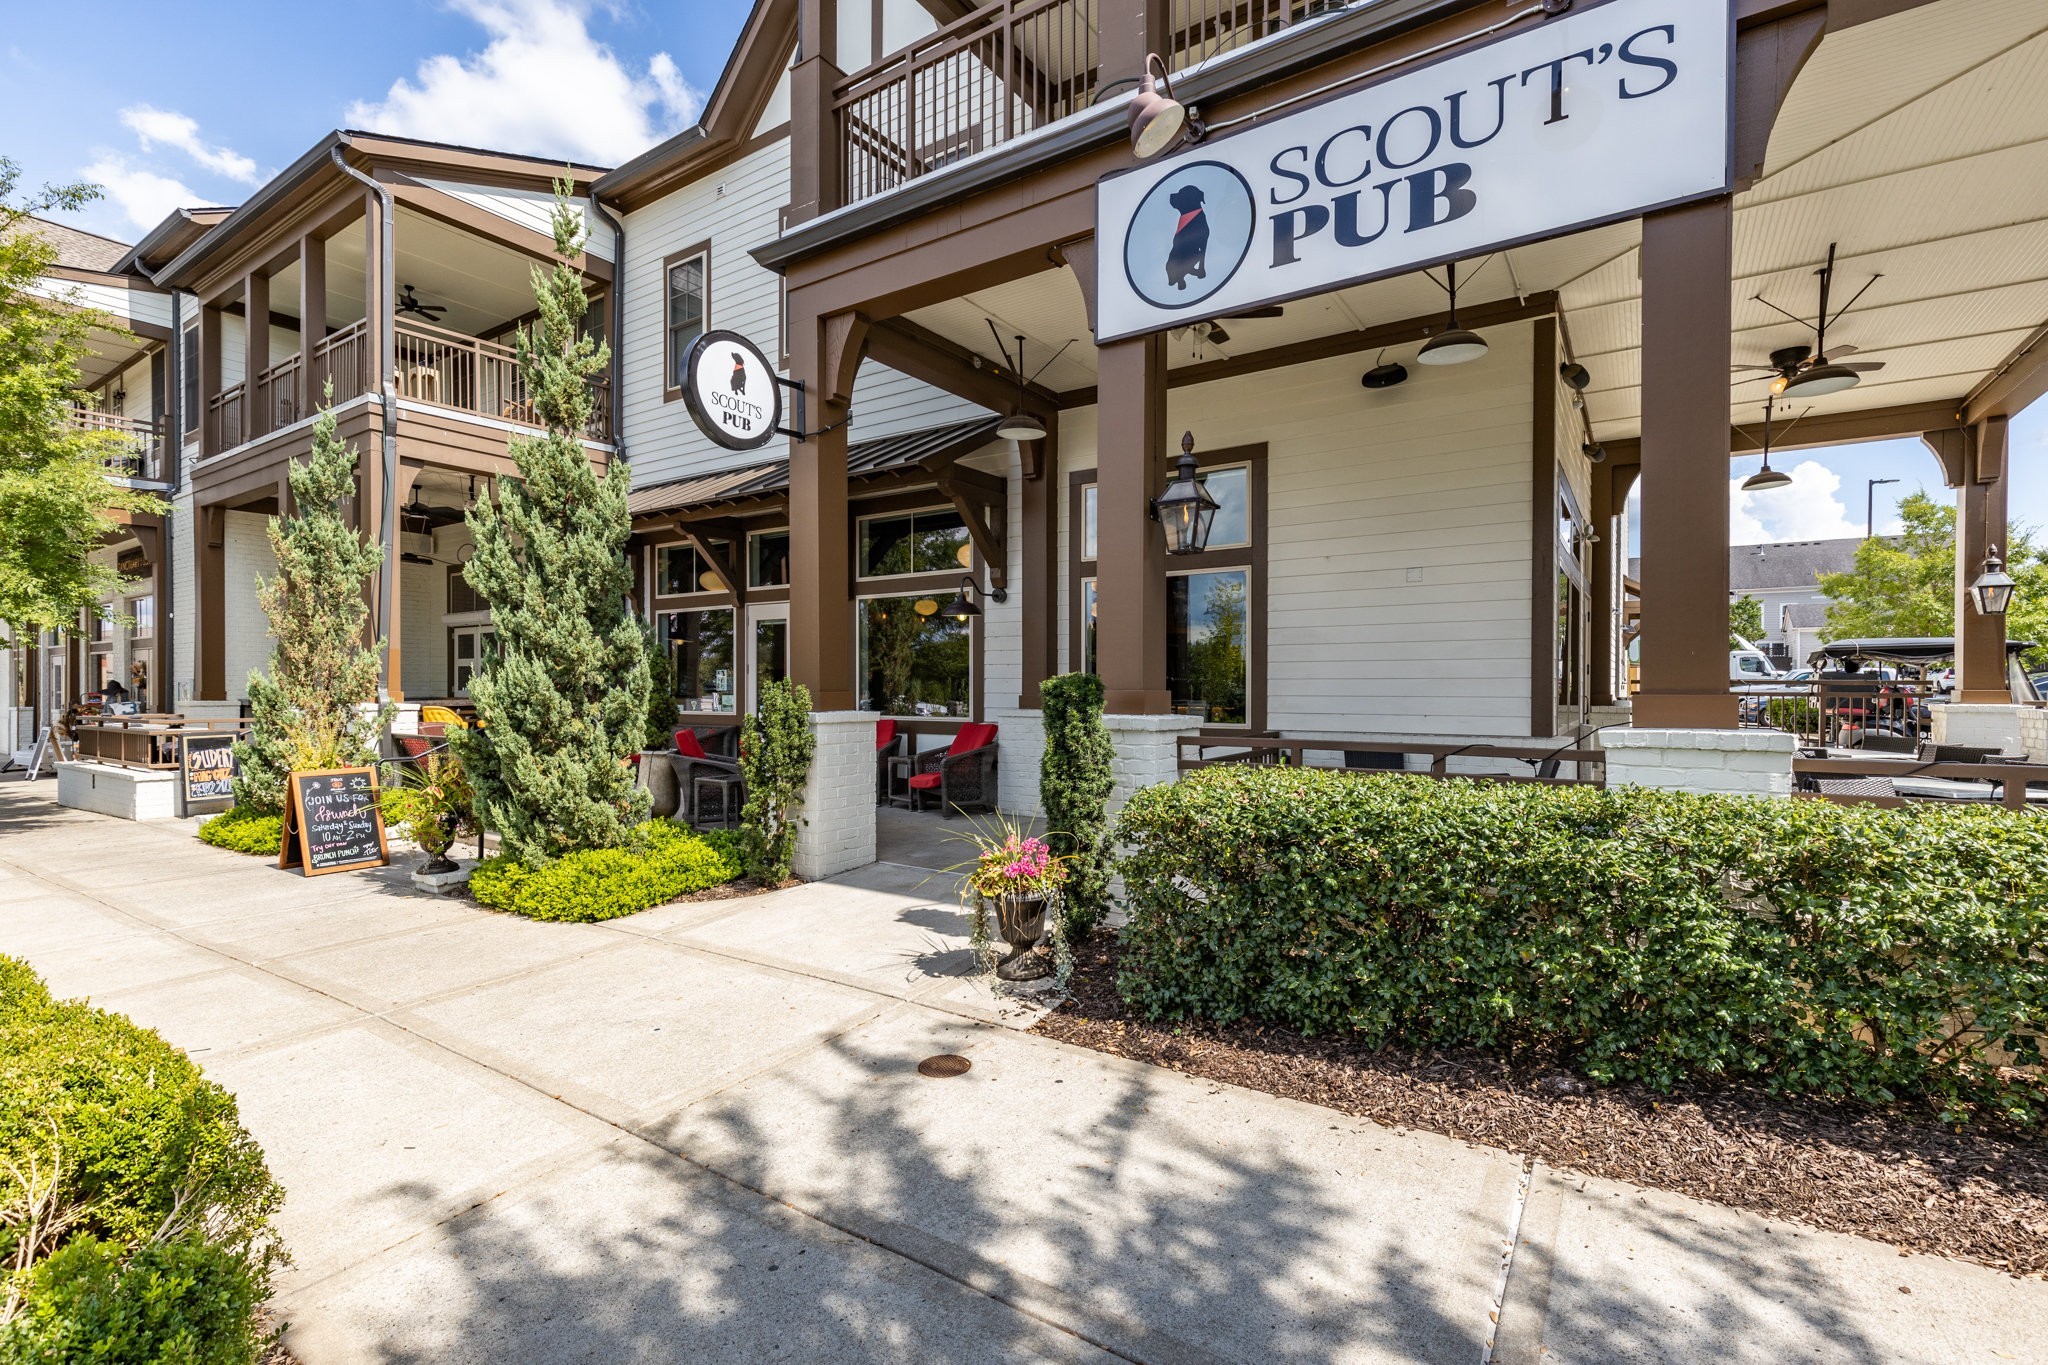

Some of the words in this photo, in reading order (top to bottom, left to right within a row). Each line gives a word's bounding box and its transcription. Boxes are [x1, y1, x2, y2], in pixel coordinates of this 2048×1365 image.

[1270, 24, 1678, 205] SCOUT'S
[1269, 161, 1477, 269] PUB
[711, 391, 762, 420] SCOUT'S
[723, 411, 751, 431] PUB
[308, 794, 332, 805] JOIN
[336, 794, 349, 802] US
[352, 793, 369, 802] FOR
[311, 822, 343, 834] Saturday
[349, 820, 371, 832] Sunday
[322, 831, 331, 842] 10
[311, 845, 324, 853] Try
[312, 851, 337, 863] BRUNCH
